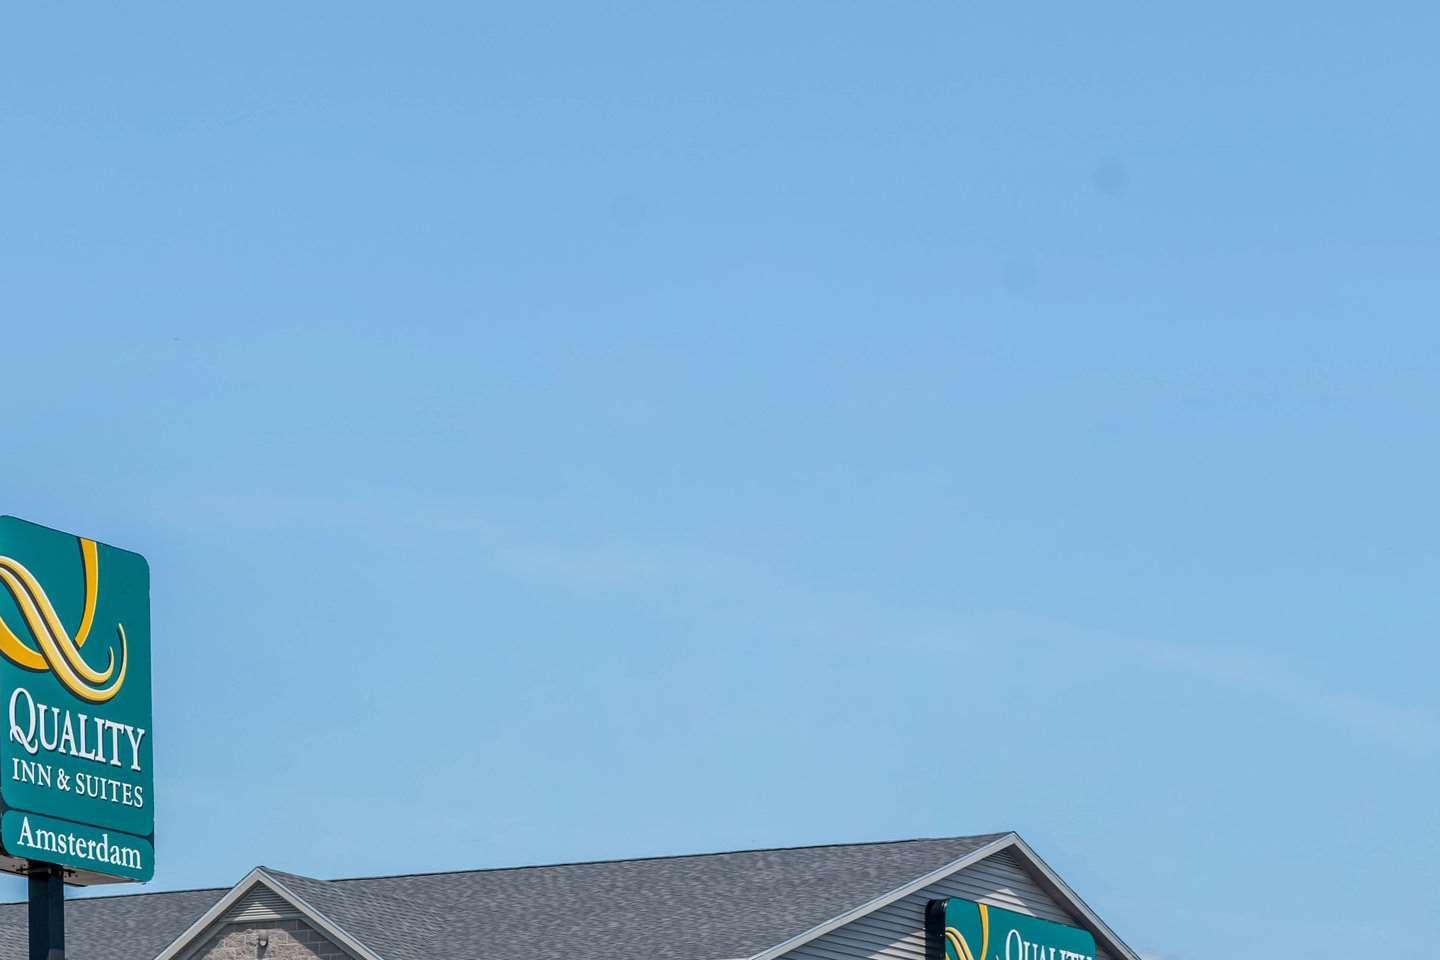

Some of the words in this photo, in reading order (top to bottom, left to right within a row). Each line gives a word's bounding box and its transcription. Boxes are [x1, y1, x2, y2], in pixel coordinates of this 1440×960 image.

[9, 687, 145, 772] QUALITY
[12, 758, 51, 788] INN
[57, 769, 72, 791] &
[75, 772, 144, 808] SUITES
[17, 816, 143, 870] Amsterdam
